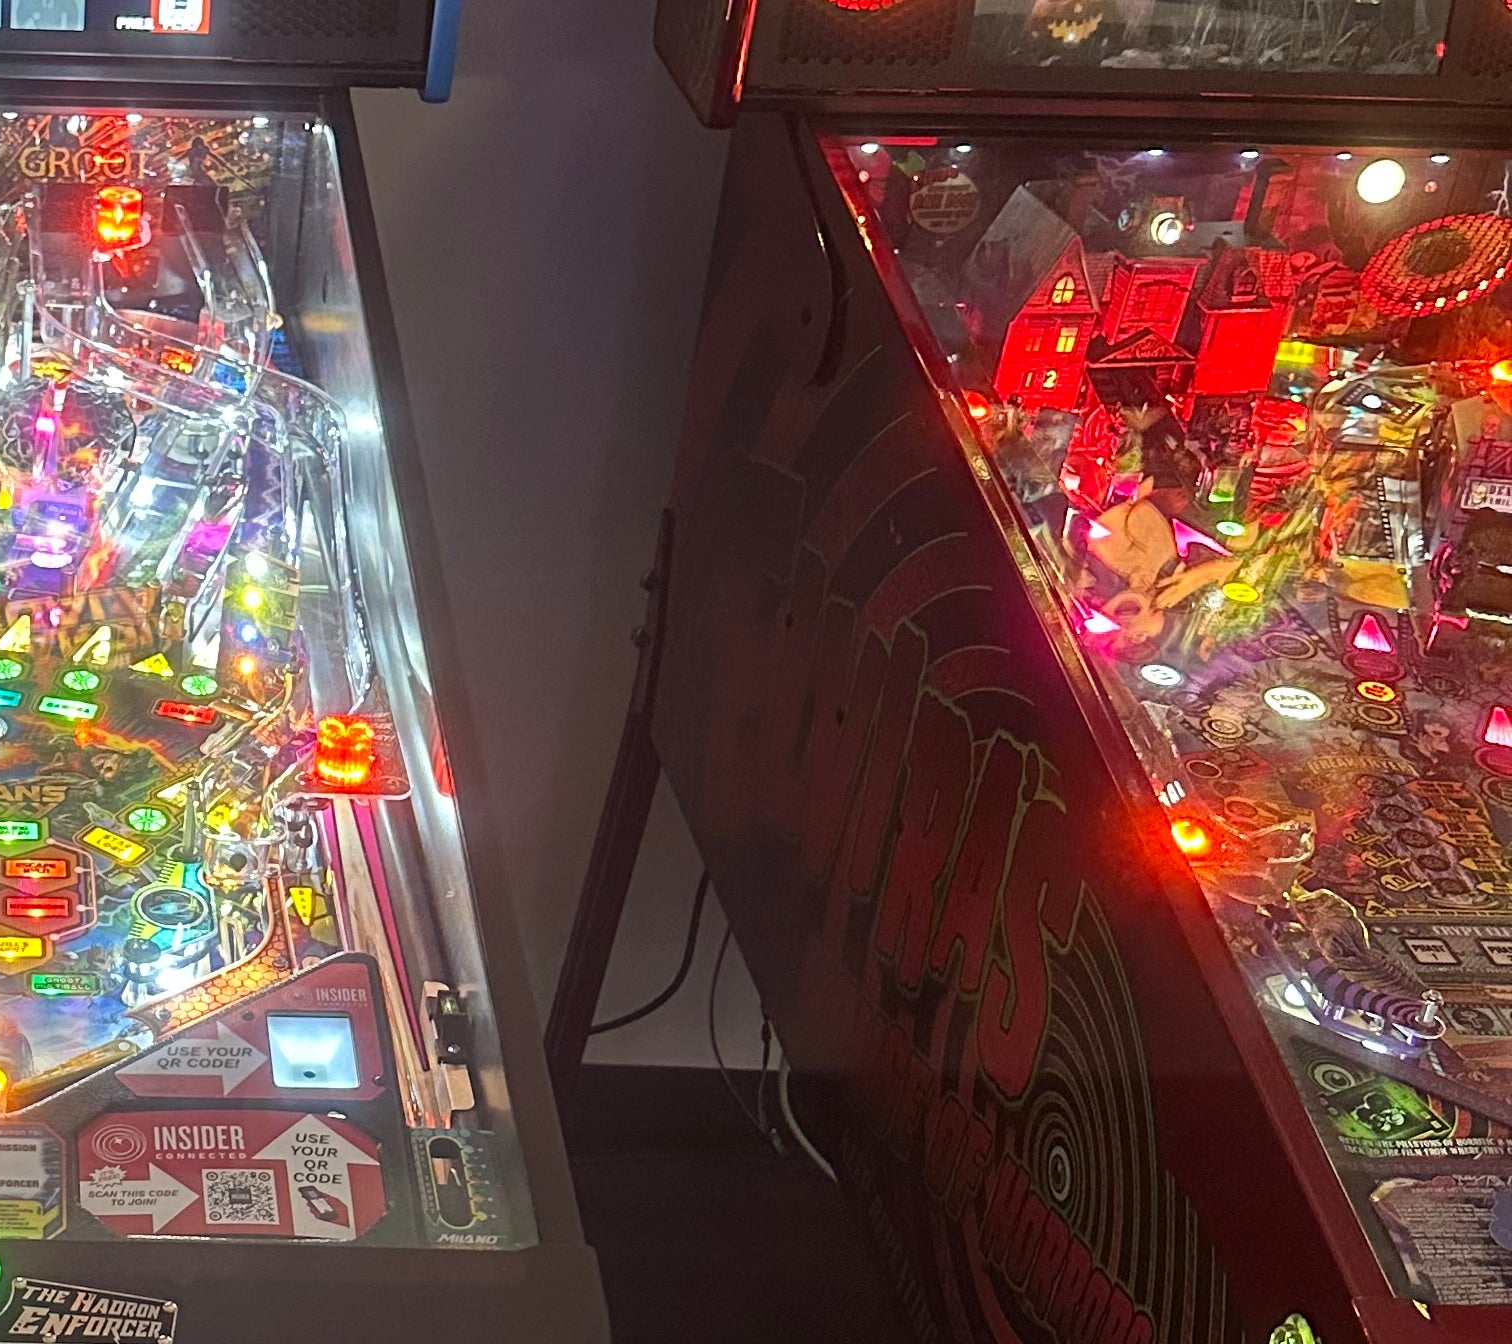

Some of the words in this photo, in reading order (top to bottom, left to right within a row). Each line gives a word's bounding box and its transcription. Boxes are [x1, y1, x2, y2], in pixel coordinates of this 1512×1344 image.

[18, 145, 156, 181] GROOT
[316, 988, 368, 1004] INSIDER
[167, 1046, 202, 1058] USE
[204, 1046, 253, 1058] YOUR
[158, 1058, 183, 1070] QR
[187, 1058, 240, 1070] CODE!
[153, 1125, 246, 1151] INSIDER
[295, 1133, 330, 1145] USE
[155, 1152, 247, 1160] CONNECTED
[290, 1145, 339, 1158] YOUR
[303, 1159, 329, 1171] QR
[293, 1172, 343, 1185] CODE
[88, 1190, 119, 1198] SCAN
[122, 1190, 145, 1198] THIS
[149, 1189, 179, 1198] CODE
[111, 1198, 126, 1206] TO
[128, 1198, 157, 1206] JOIN!
[437, 1233, 501, 1244] MILANO
[23, 1285, 66, 1306] THE
[70, 1288, 162, 1320] HADRON
[9, 1306, 165, 1344] ENFORCER
